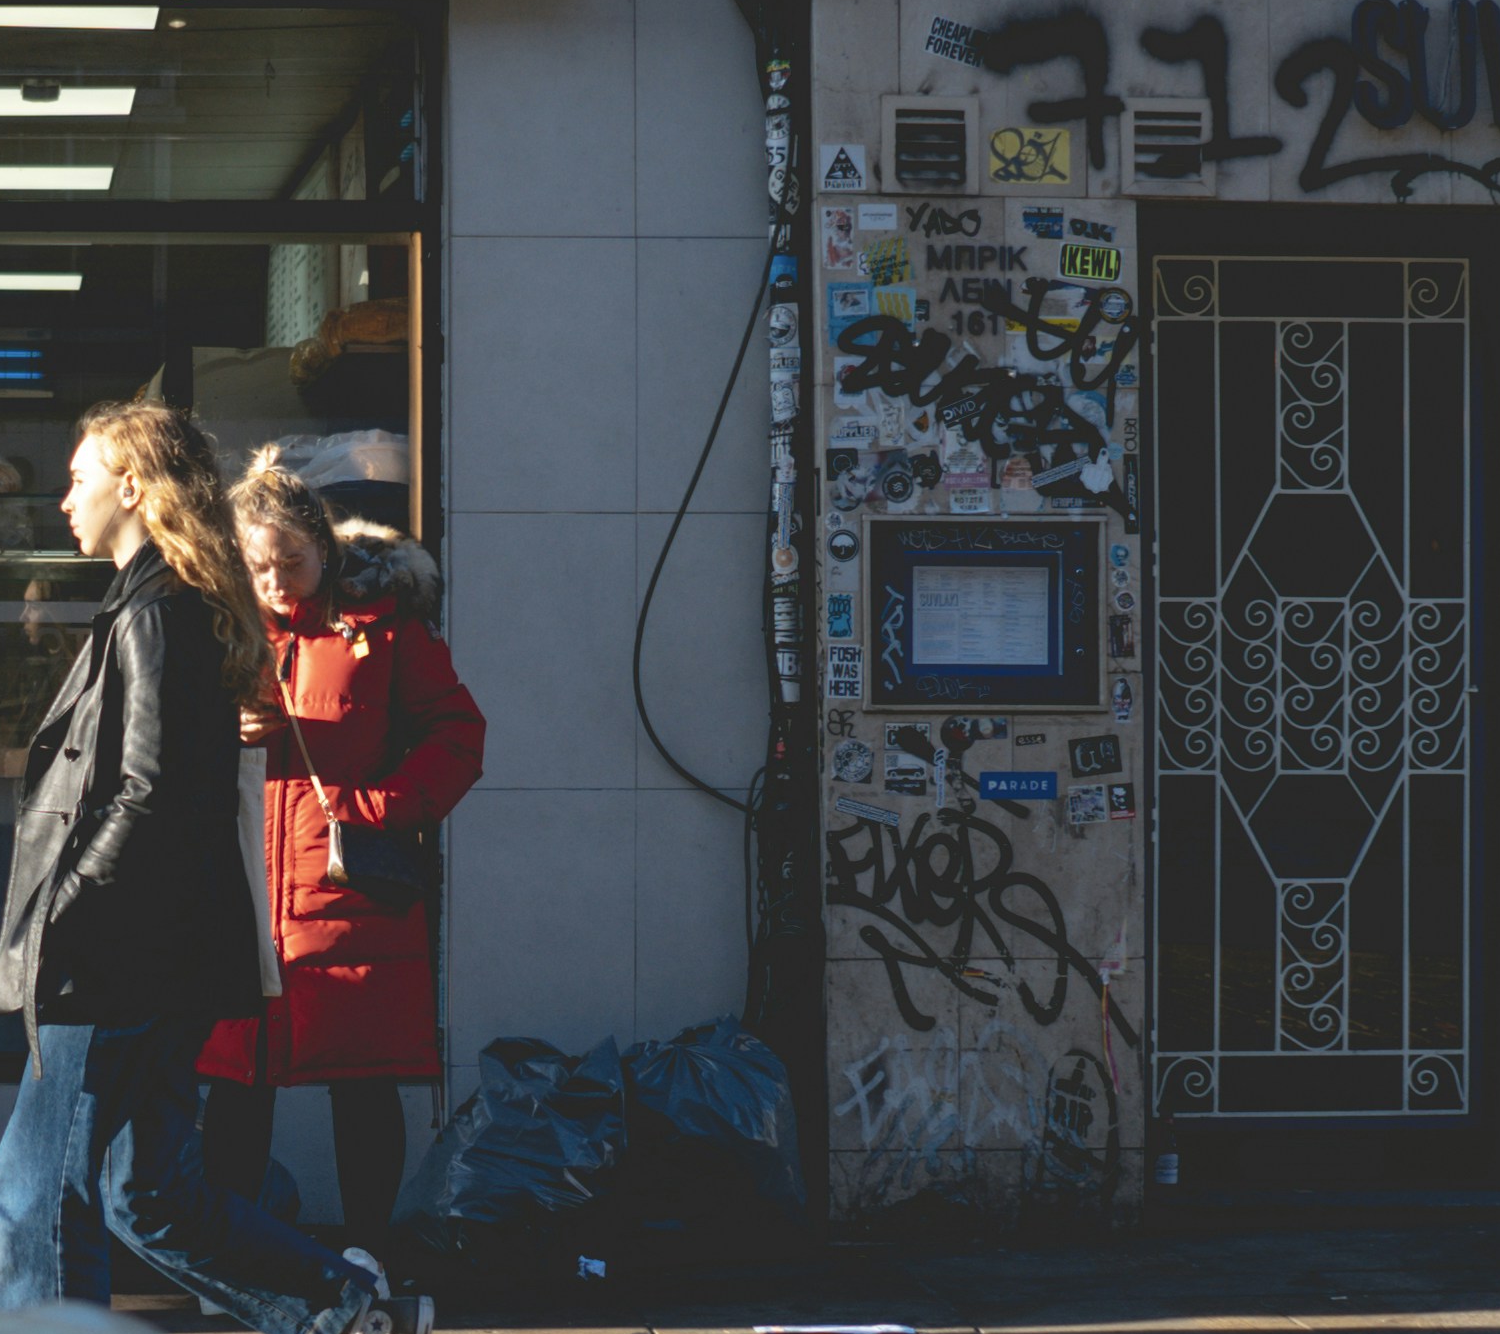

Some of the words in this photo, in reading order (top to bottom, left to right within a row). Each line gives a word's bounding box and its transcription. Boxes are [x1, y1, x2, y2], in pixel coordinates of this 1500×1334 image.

[1067, 246, 1114, 279] KEWL
[833, 664, 859, 679] WAS
[829, 680, 860, 697] HERE
[987, 779, 1049, 792] PARADE
